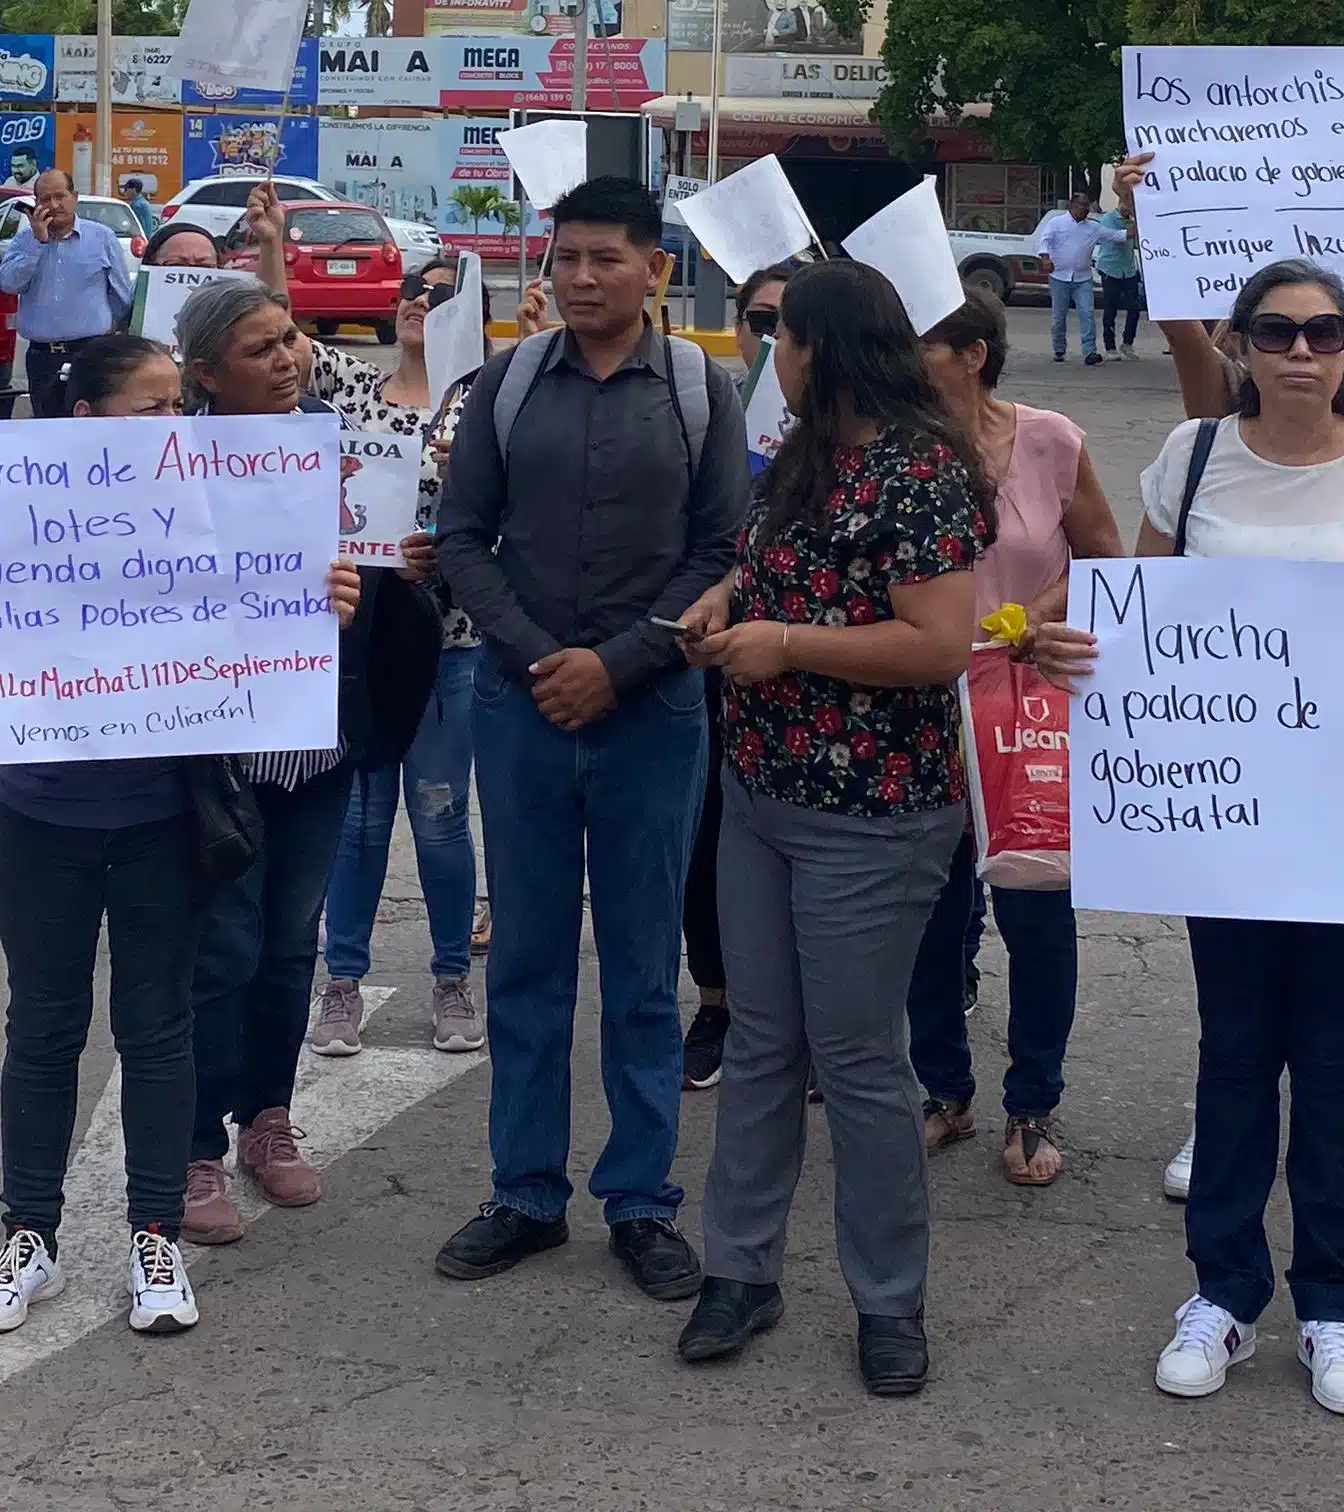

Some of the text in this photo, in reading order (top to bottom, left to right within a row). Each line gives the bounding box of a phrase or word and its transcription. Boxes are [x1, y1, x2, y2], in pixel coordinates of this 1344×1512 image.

[464, 48, 520, 68] MEGA
[783, 63, 889, 82] LAS DELIC
[1135, 52, 1191, 106] Los
[0, 116, 46, 145] 90.9
[732, 111, 872, 126] COCINA ECONOMICA
[1134, 116, 1308, 148] marcharemos
[463, 126, 510, 144] MEG
[112, 155, 125, 164] 68
[459, 168, 471, 178] de
[473, 169, 484, 178] tu
[1144, 168, 1160, 191] a
[1169, 160, 1247, 192] palacio
[1256, 156, 1281, 185] de
[668, 189, 695, 199] ENTR
[678, 180, 699, 192] SOLO
[1179, 224, 1275, 263] Enrique
[87, 448, 136, 486] de
[155, 431, 322, 483] Antorcha
[30, 505, 137, 544] lotes
[339, 540, 396, 557] ENTE
[122, 549, 219, 595] digna
[234, 550, 303, 584] para
[80, 599, 184, 632] pobres
[194, 596, 227, 623] de
[1090, 564, 1291, 676] Marcha
[1084, 677, 1320, 738] a palacio de
[101, 722, 136, 736] en
[1091, 748, 1242, 825] gobierno
[1120, 794, 1260, 833] estatal
